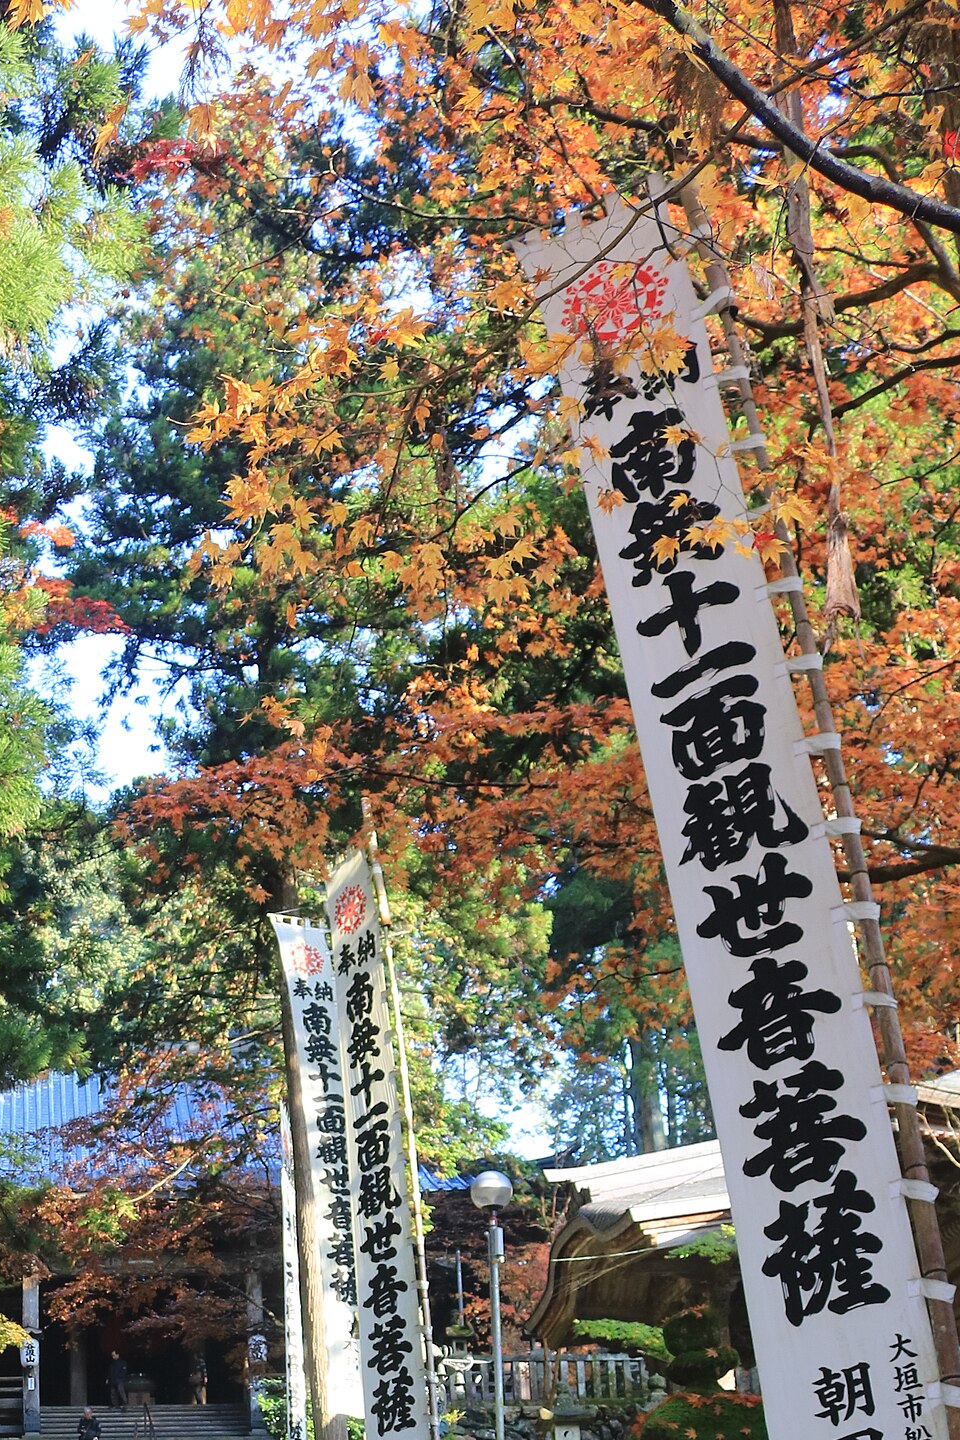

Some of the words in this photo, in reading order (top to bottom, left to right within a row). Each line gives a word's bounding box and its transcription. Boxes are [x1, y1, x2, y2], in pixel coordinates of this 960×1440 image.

[292, 977, 334, 1003] 奉納
[337, 930, 376, 977] 奉納
[301, 1002, 358, 1306] 南無十一面観世音菩薩
[345, 972, 417, 1437] 南無十一面観世音菩薩
